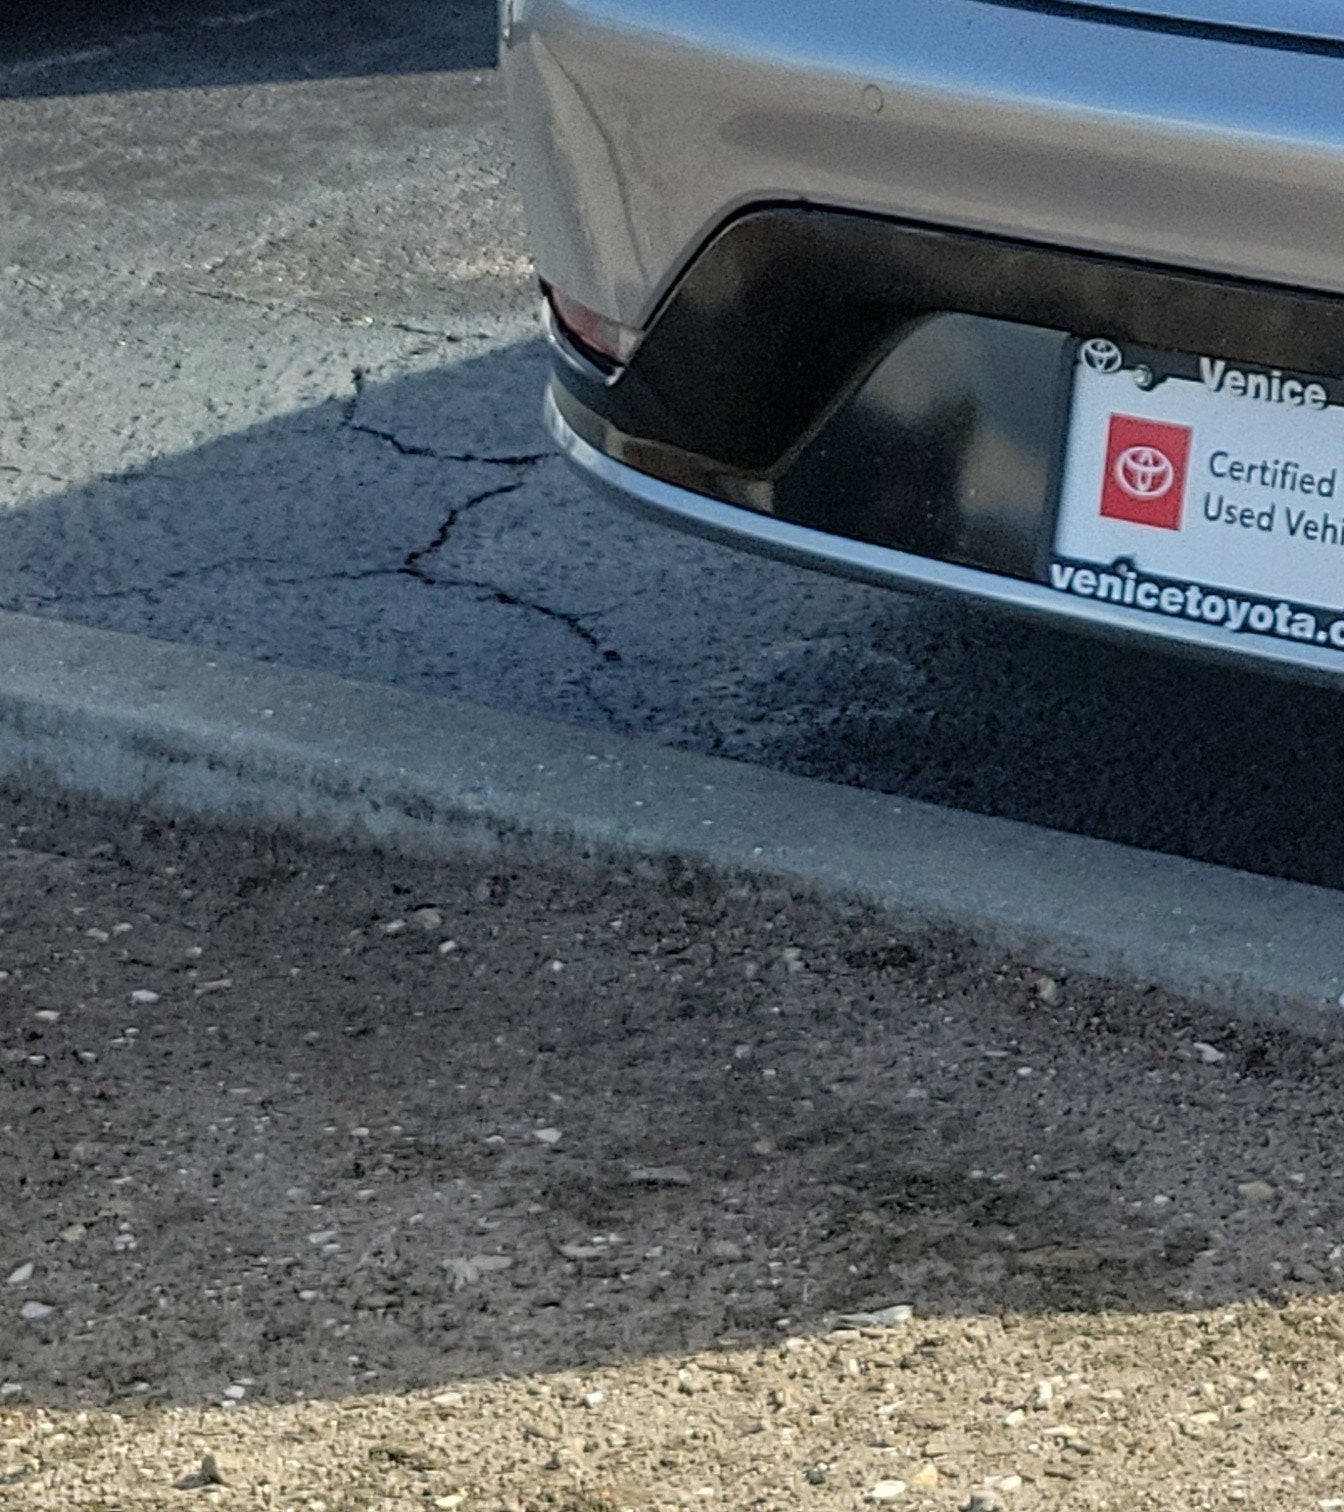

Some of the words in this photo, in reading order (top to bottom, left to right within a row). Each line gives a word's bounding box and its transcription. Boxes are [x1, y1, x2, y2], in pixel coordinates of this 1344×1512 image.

[1199, 357, 1329, 410] Venice
[1208, 449, 1337, 499] Certified
[1203, 492, 1275, 532] Used
